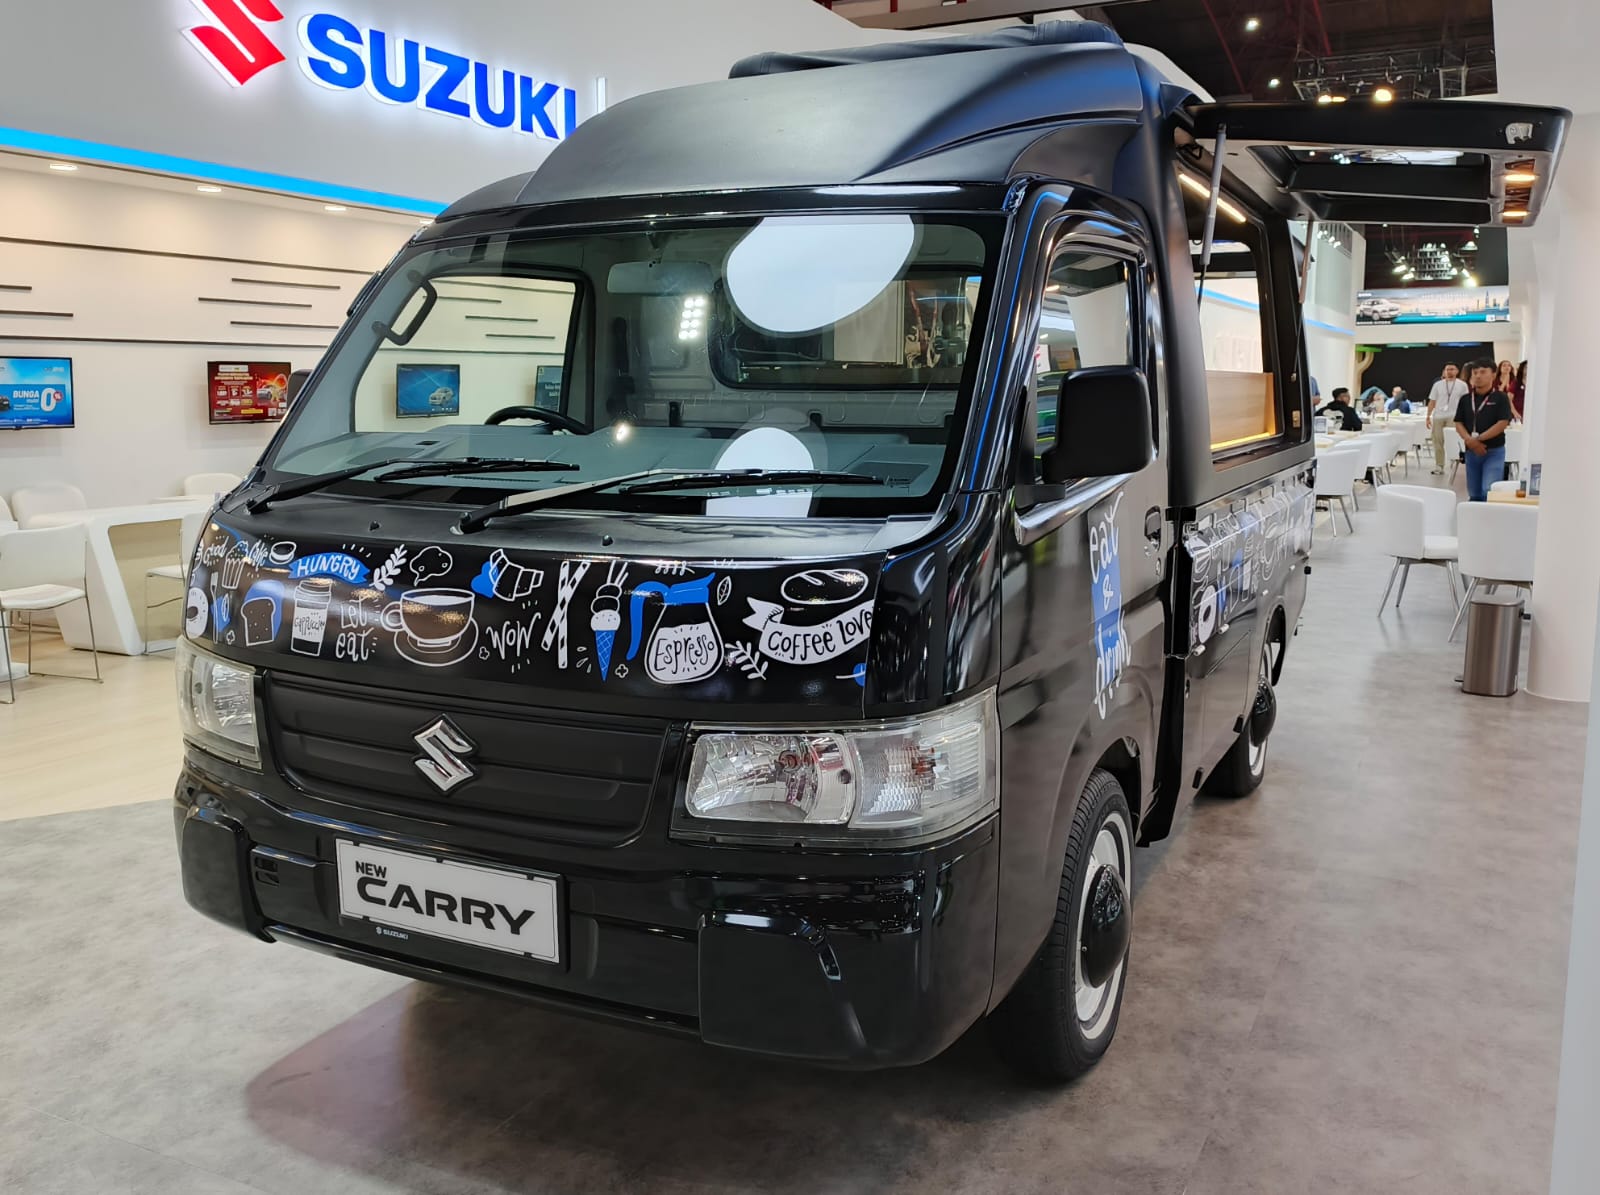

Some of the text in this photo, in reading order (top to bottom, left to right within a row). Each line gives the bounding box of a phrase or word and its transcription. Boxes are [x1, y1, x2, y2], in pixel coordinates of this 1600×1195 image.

[298, 13, 577, 140] SUZUKI
[13, 390, 39, 399] BUNGA
[296, 554, 361, 582] HUNGRY
[1102, 574, 1114, 610] &
[335, 627, 375, 662] eat
[355, 861, 387, 879] NEW
[357, 876, 536, 936] CARRY
[383, 929, 409, 940] SUZUKI
